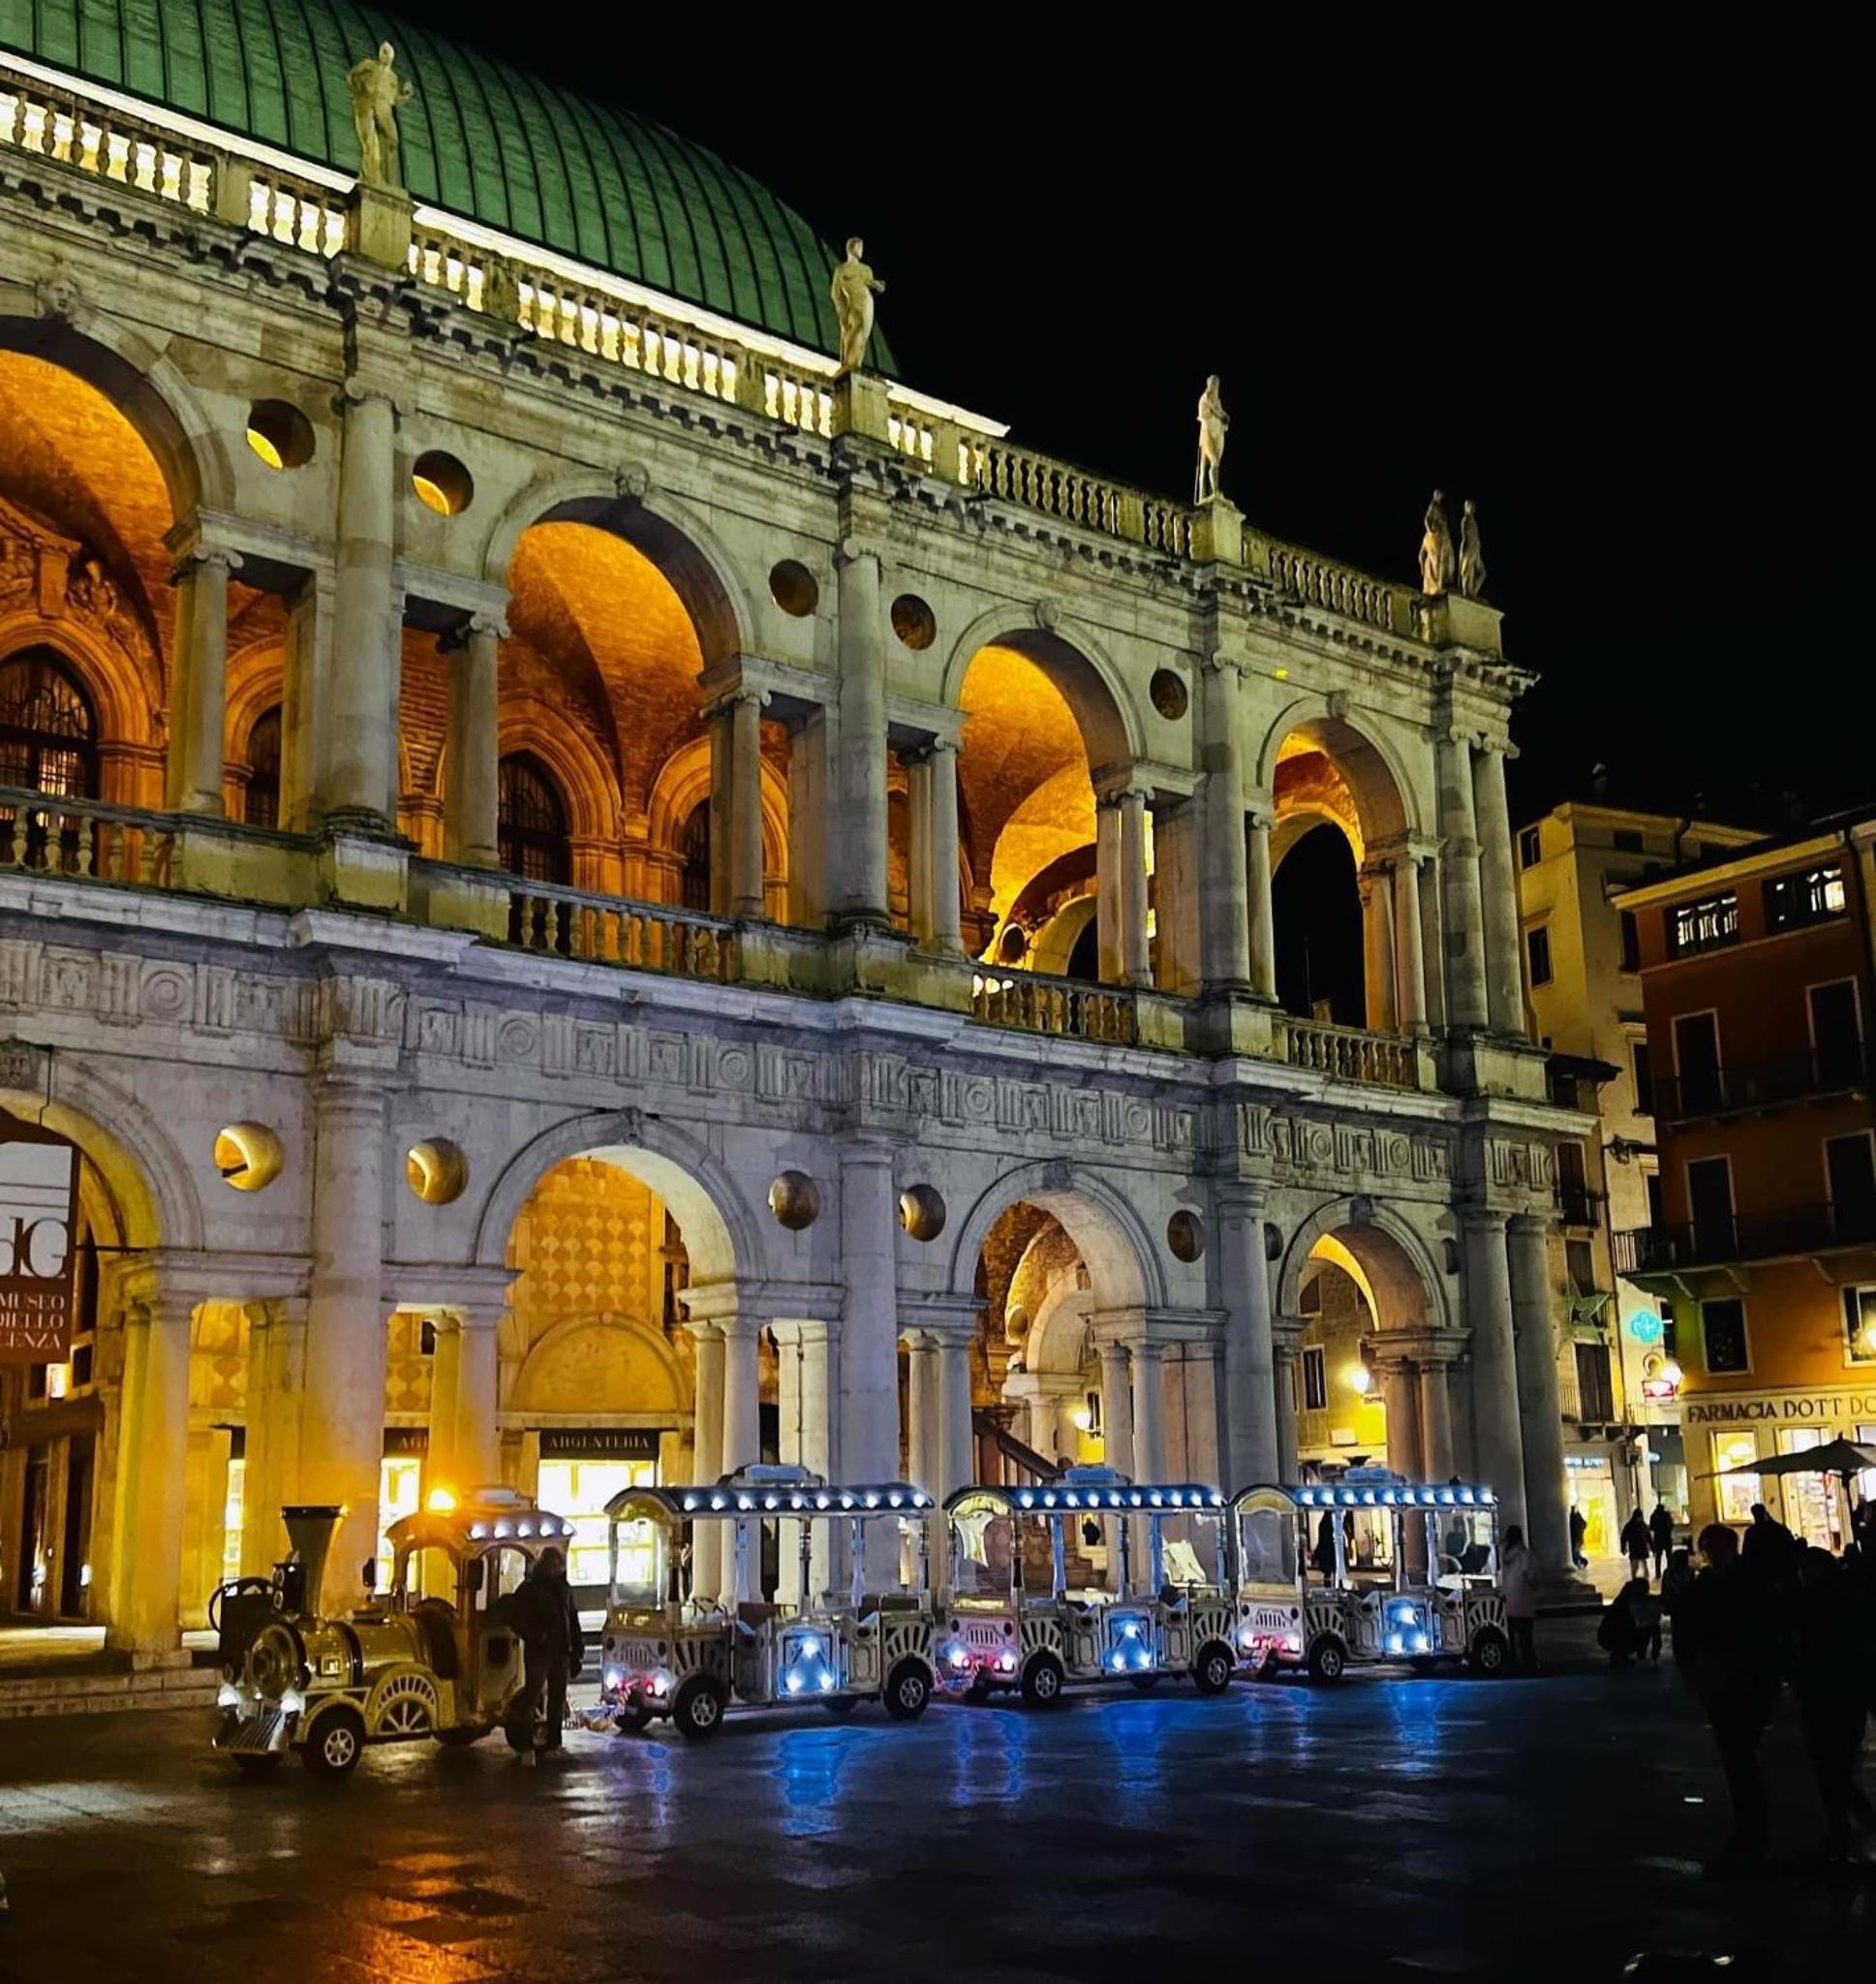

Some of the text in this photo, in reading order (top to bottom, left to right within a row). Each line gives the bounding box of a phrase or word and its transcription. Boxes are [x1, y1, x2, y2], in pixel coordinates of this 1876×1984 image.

[1688, 1401, 1777, 1423] FARMACIA
[1784, 1398, 1842, 1418] DOTT
[549, 1435, 650, 1449] ARGENTERIA
